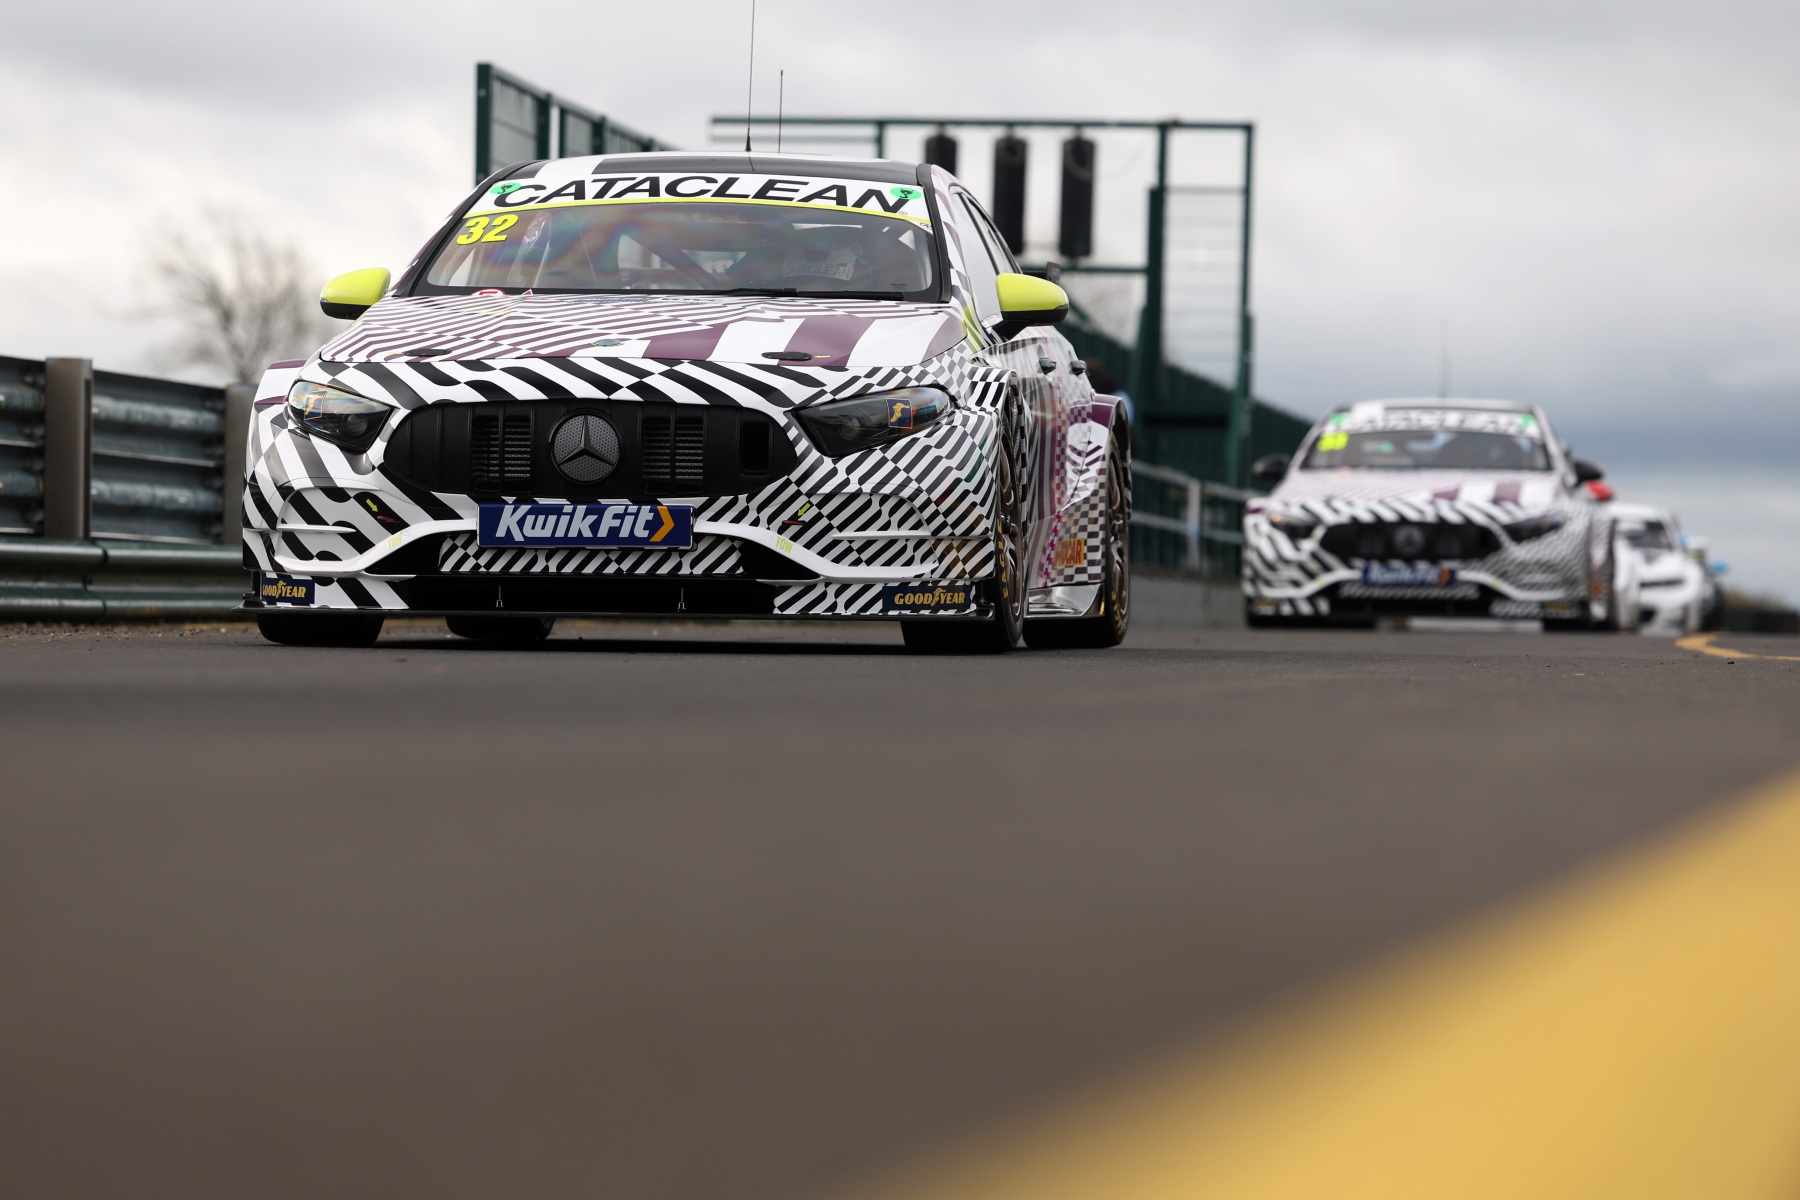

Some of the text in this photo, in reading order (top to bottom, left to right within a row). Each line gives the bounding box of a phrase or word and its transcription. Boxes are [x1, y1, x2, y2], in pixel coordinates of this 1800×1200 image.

[494, 176, 909, 214] CATACLEAN
[456, 214, 519, 245] 32
[388, 532, 403, 550] TOW
[775, 536, 794, 554] TOW
[996, 518, 1009, 599] EAGLE
